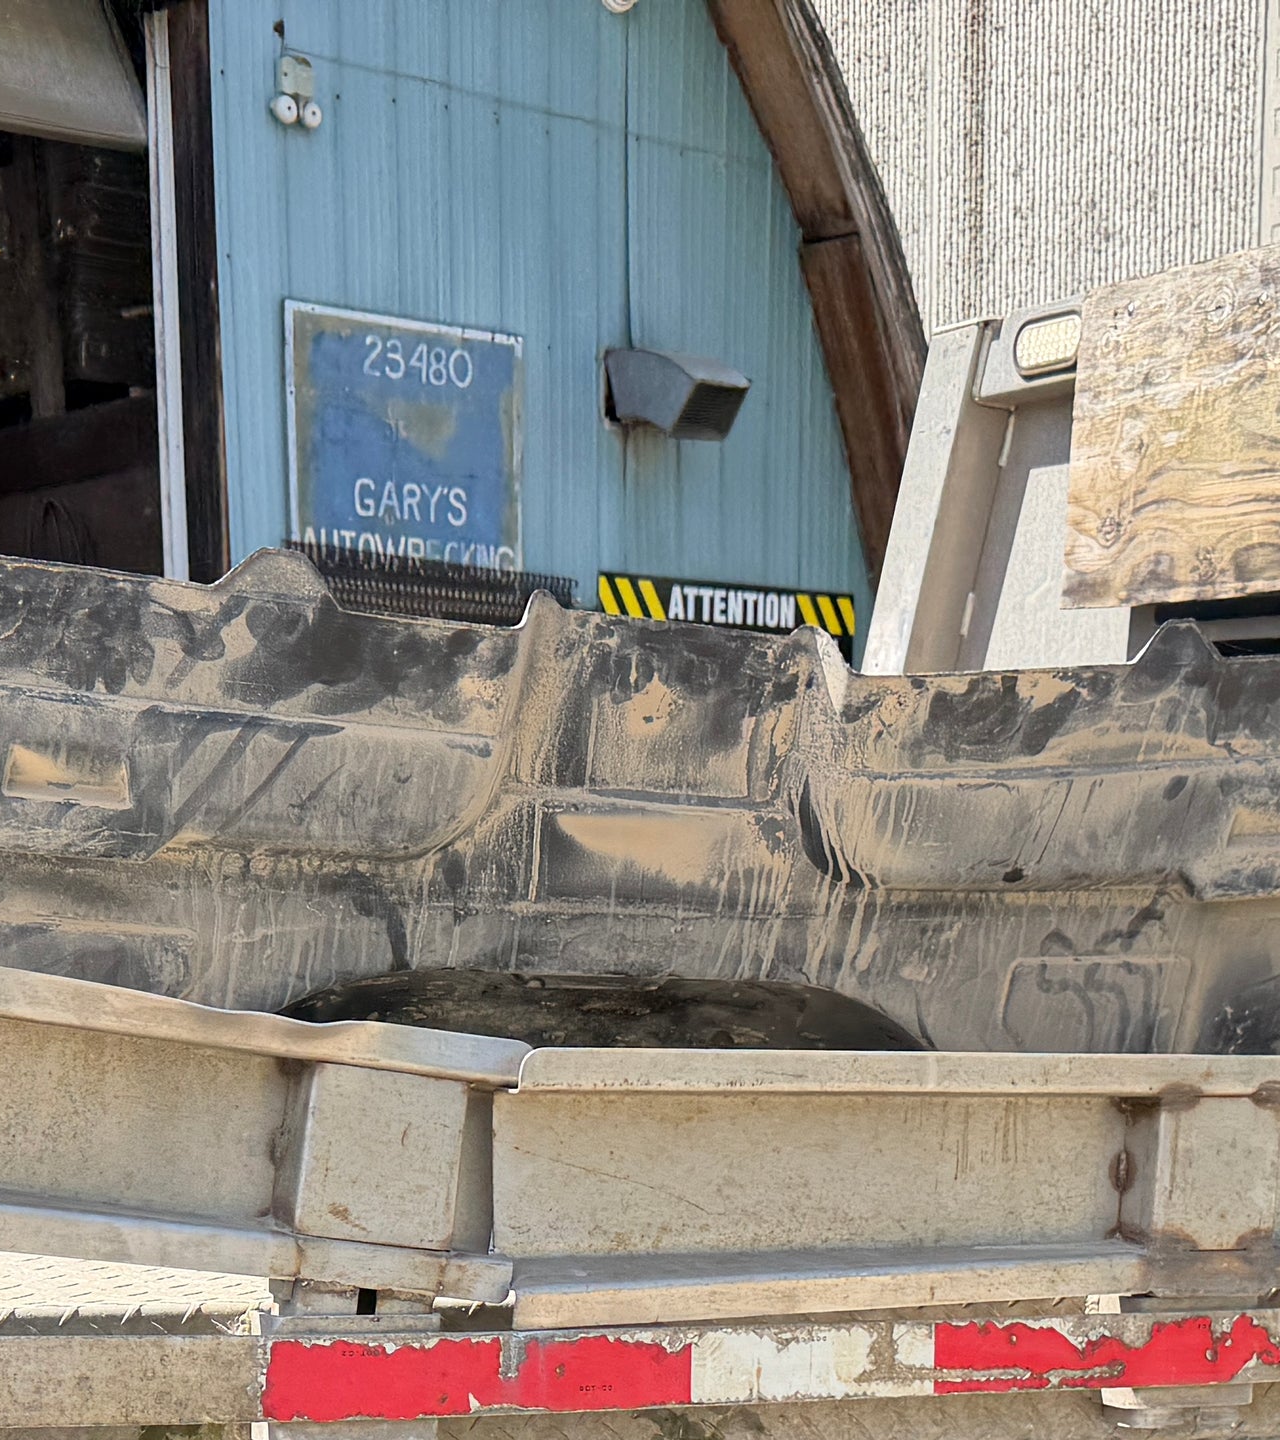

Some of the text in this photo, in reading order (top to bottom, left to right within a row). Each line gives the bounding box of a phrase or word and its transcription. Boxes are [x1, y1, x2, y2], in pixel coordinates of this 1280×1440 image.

[363, 335, 473, 389] 23480
[353, 477, 468, 527] GARY'S
[668, 583, 796, 630] ATTENTION
